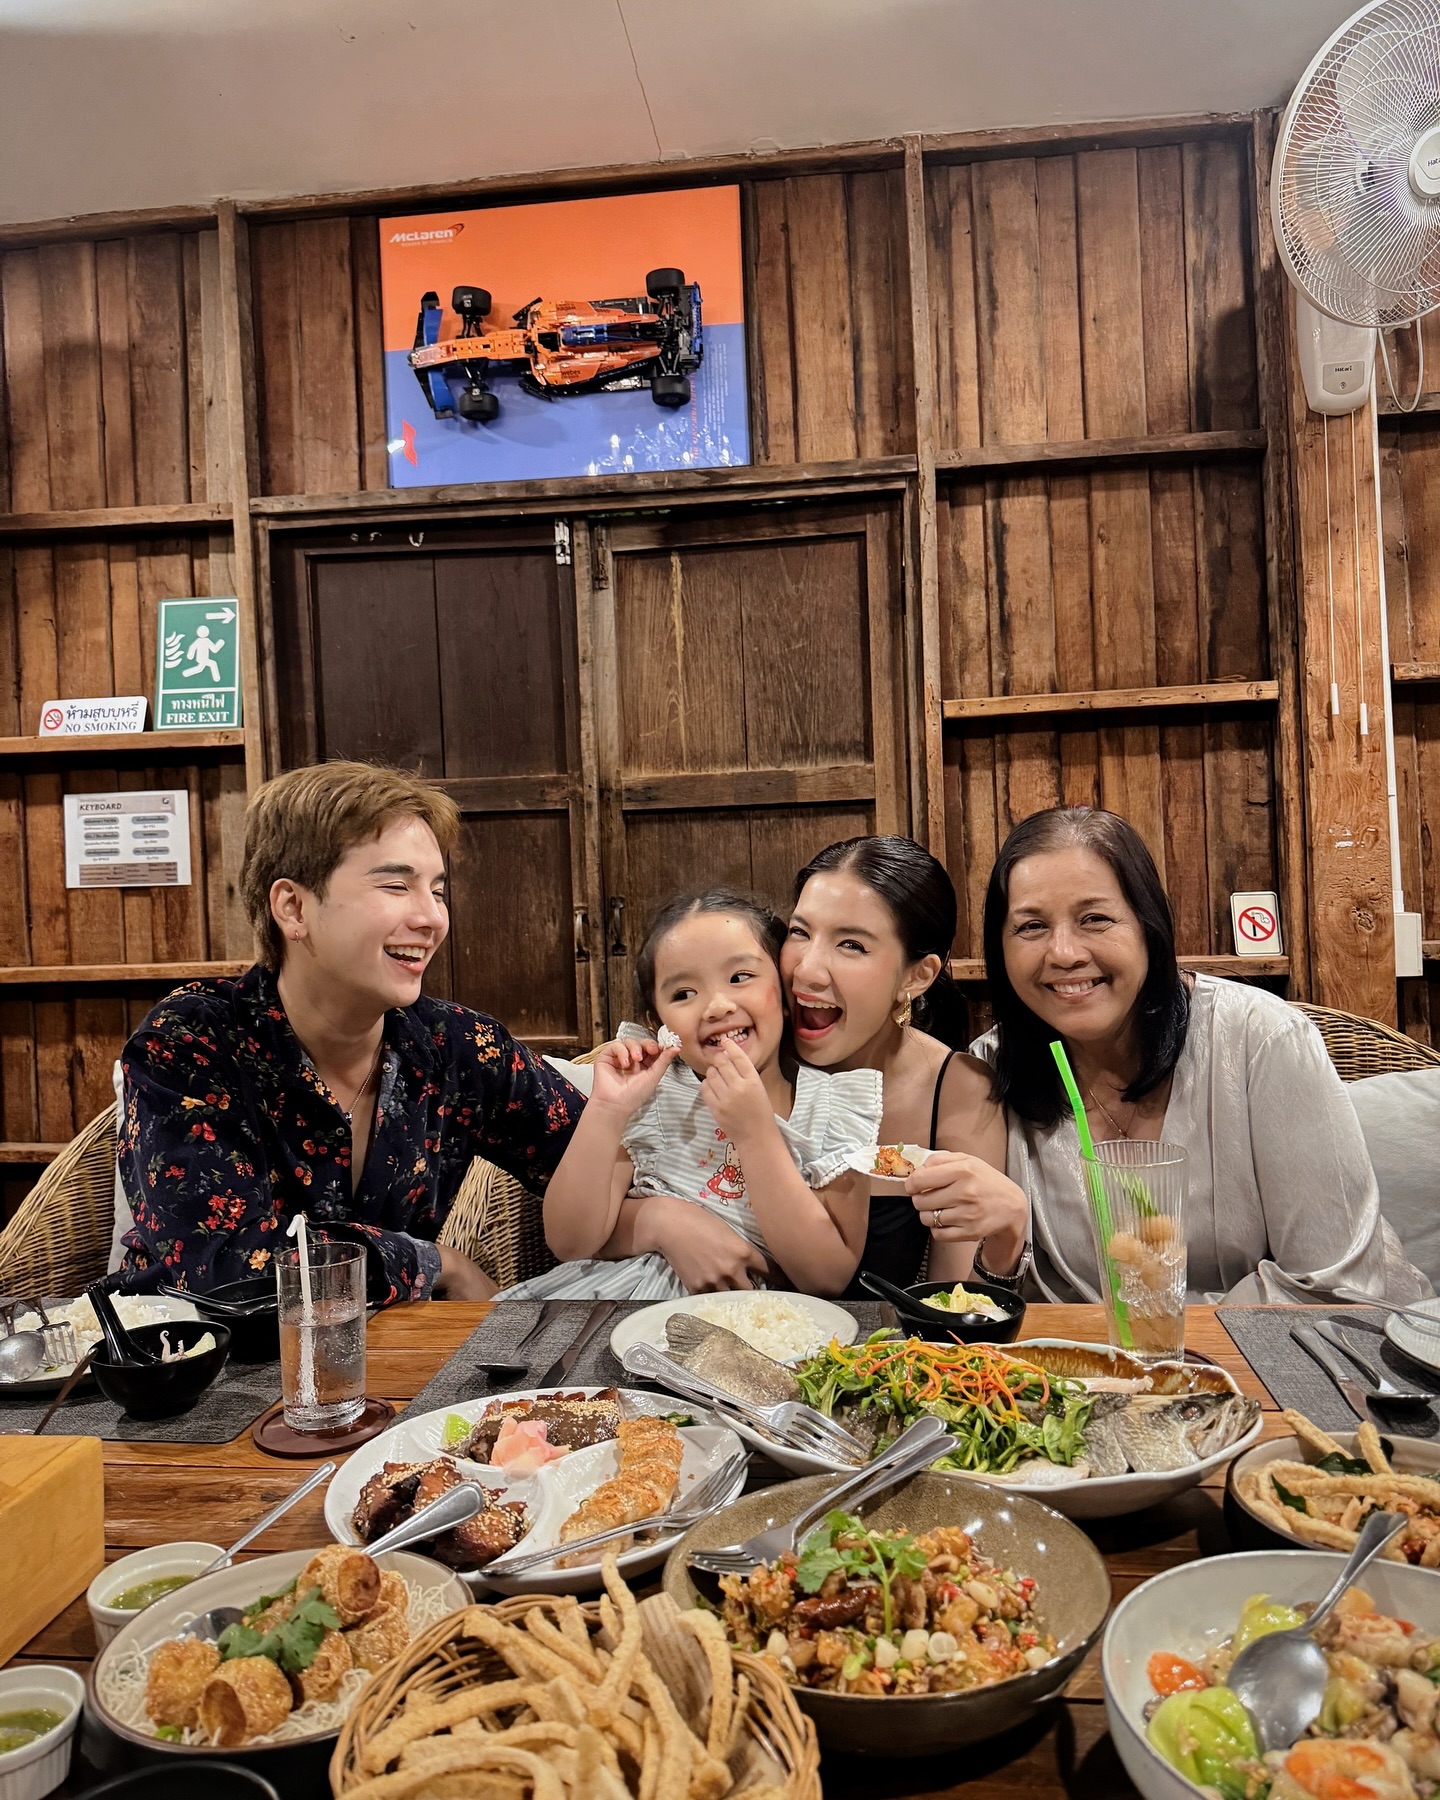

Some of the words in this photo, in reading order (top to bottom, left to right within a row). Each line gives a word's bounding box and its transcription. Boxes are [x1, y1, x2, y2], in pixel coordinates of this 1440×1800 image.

[389, 229, 454, 243] McLaren
[171, 693, 225, 710] ทางหนีไฟ
[66, 701, 140, 721] ห้ามสูบบุหรี่
[166, 712, 196, 724] FIRE
[198, 711, 230, 722] EXIT
[65, 723, 81, 733] NO
[84, 721, 137, 732] SMOKING
[79, 803, 122, 811] KEYBOARD
